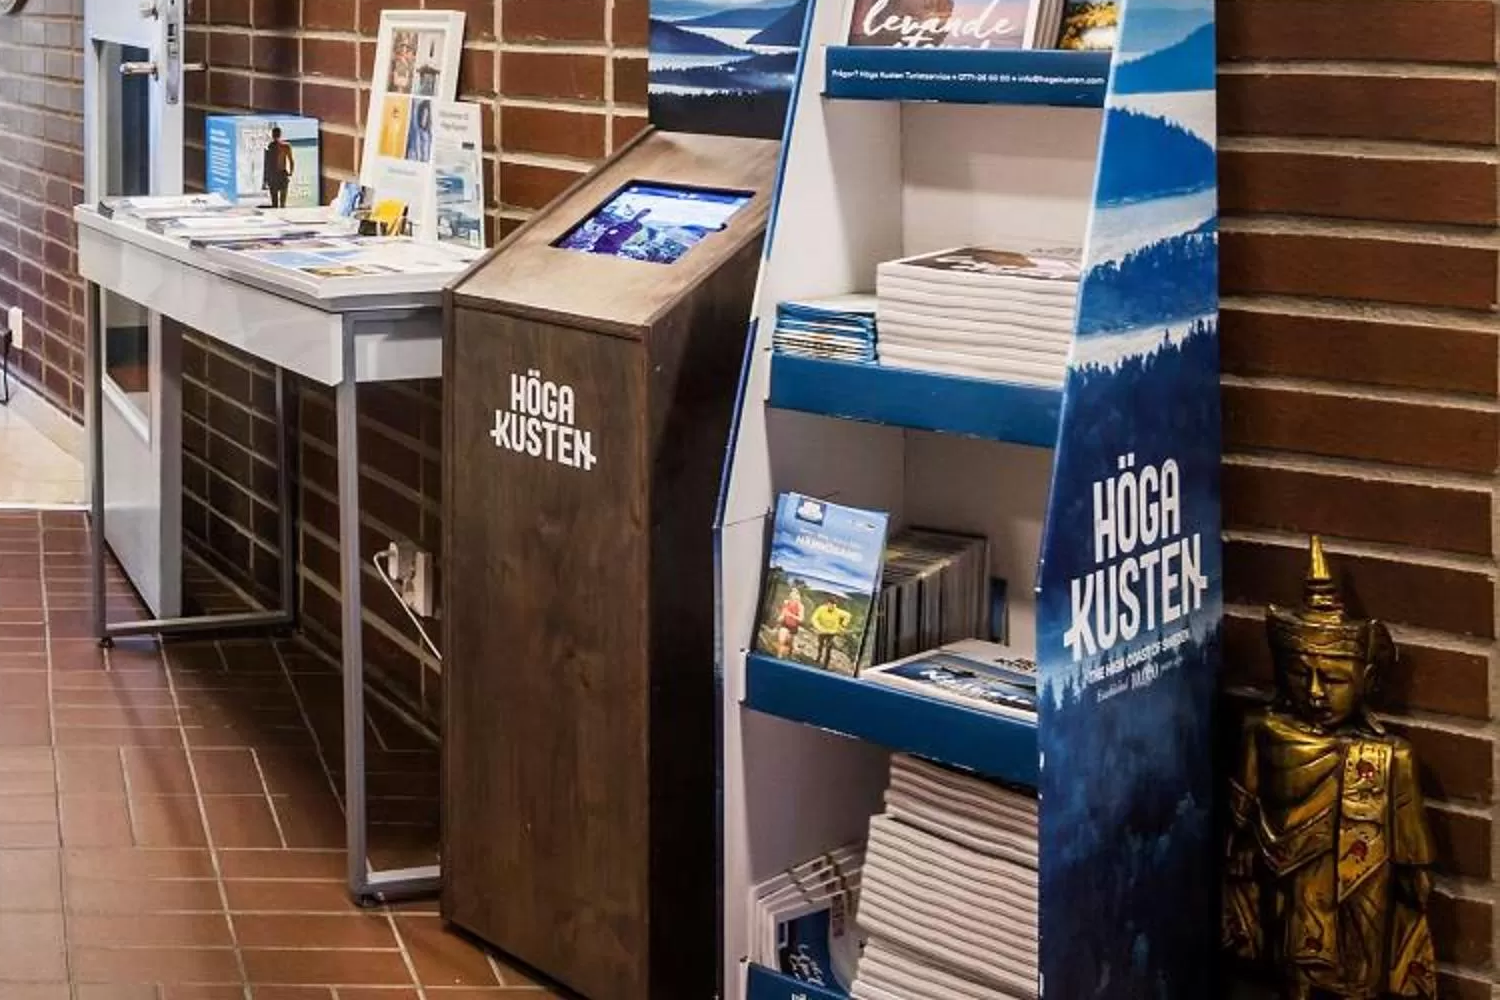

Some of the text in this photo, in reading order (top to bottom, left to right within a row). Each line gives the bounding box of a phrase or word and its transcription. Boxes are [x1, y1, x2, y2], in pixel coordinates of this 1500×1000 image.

[490, 409, 597, 470] KUSTEN
[510, 368, 575, 425] HÖGA
[1093, 452, 1180, 563] HÖGA
[1063, 534, 1208, 662] KUSTEN
